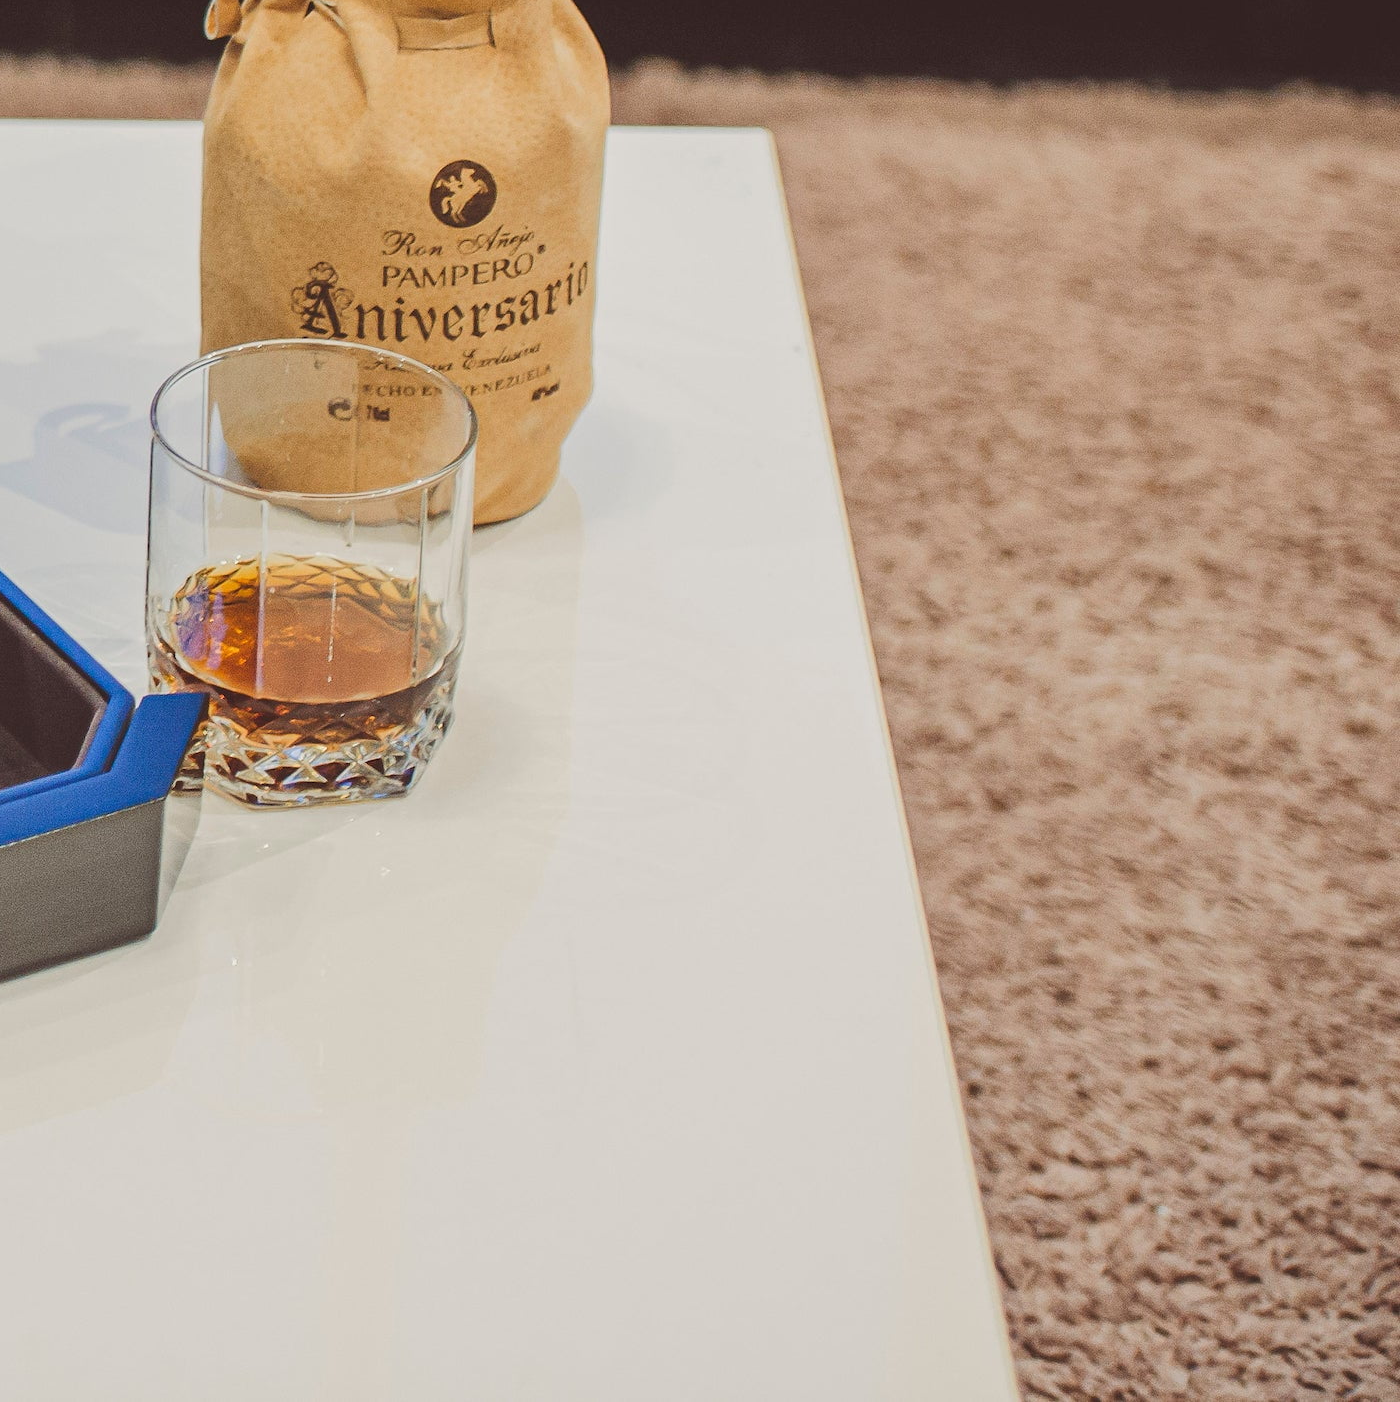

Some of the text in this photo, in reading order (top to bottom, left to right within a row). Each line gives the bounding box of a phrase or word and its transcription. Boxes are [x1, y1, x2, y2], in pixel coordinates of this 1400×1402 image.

[381, 229, 444, 257] Ron
[381, 252, 534, 289] PAMPERO
[299, 261, 589, 343] Aniversario
